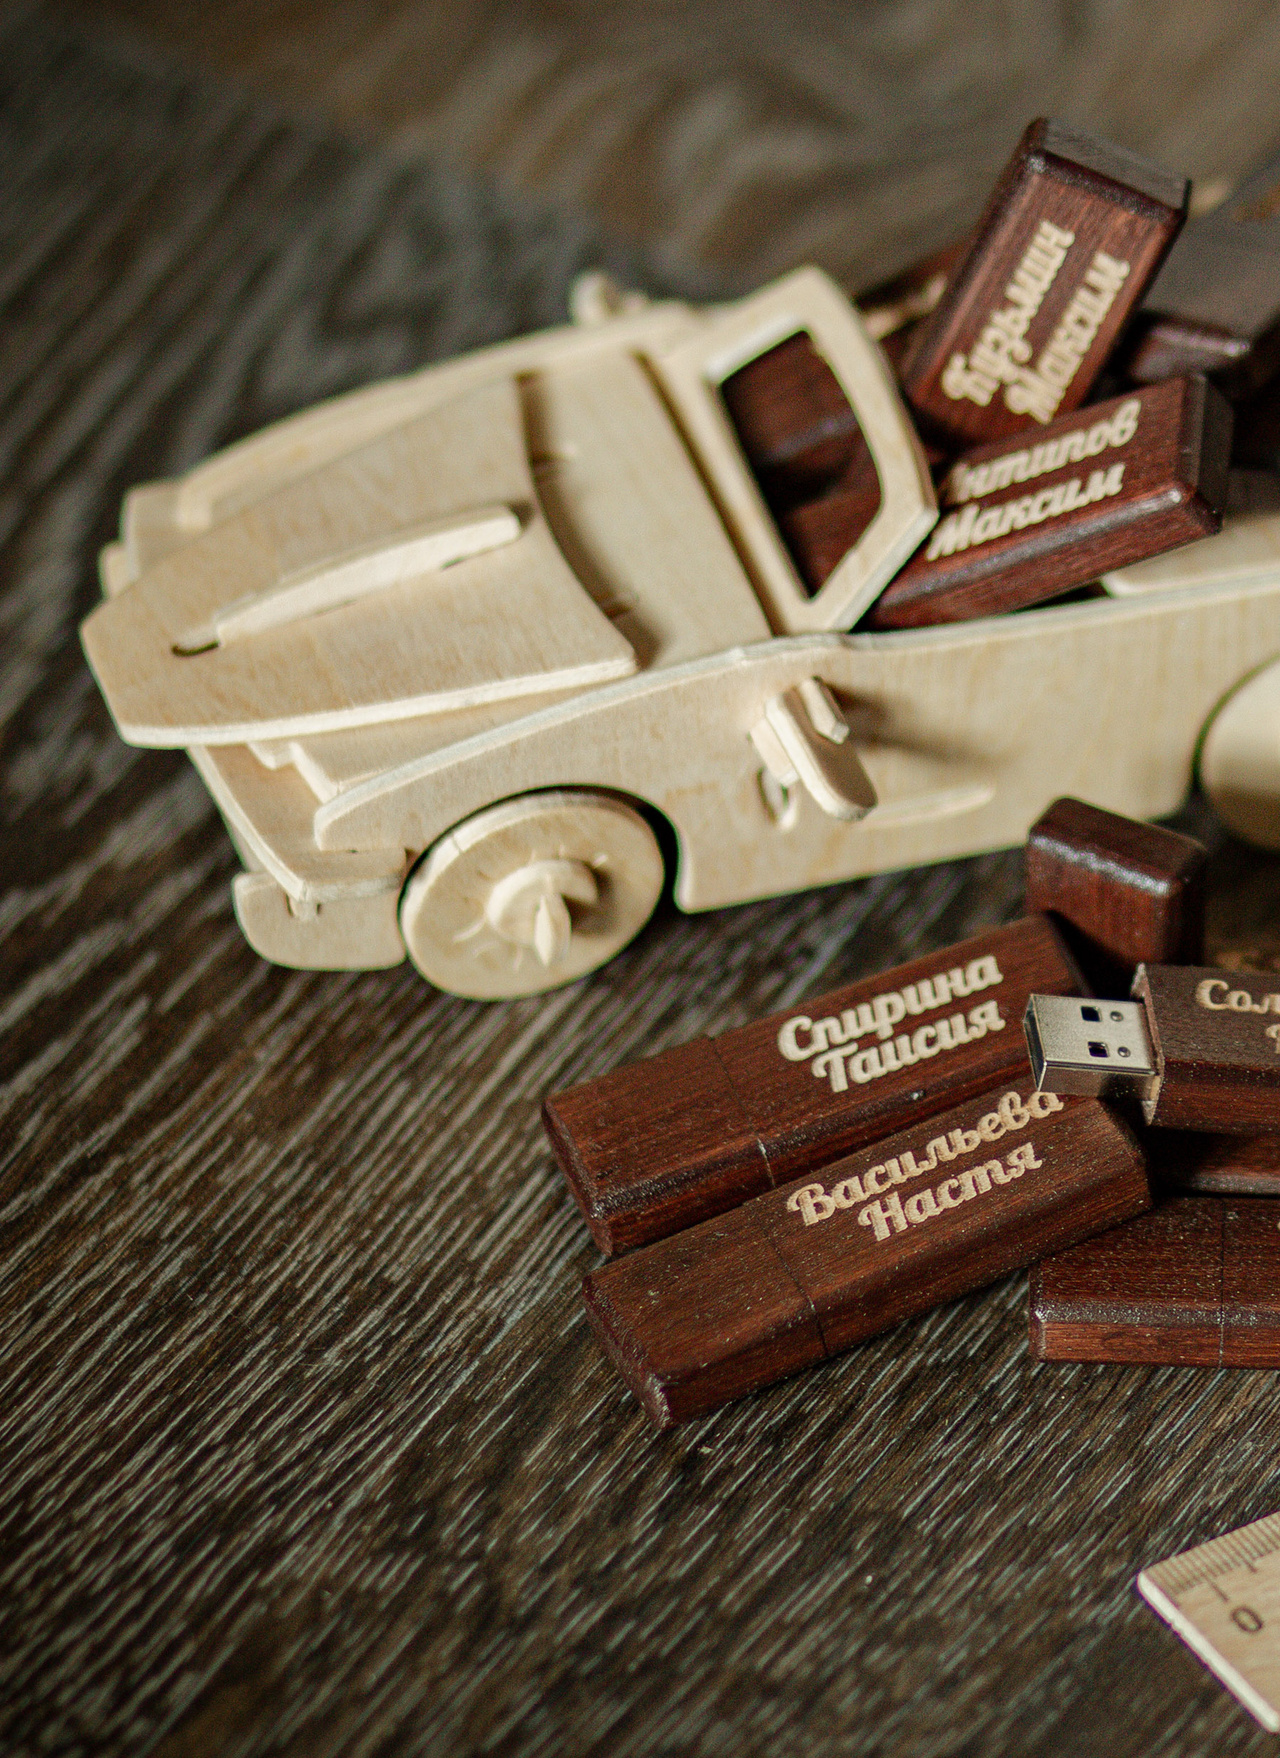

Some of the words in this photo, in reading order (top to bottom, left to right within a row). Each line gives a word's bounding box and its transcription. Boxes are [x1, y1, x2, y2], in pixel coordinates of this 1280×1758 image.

[1005, 252, 1130, 424] Максим
[925, 463, 1125, 561] Максим
[777, 955, 1003, 1061] Спирина
[811, 1000, 1005, 1093] Таисия
[787, 1091, 1064, 1226] Васильева
[858, 1141, 1042, 1241] Настя
[1229, 1605, 1265, 1635] 0
